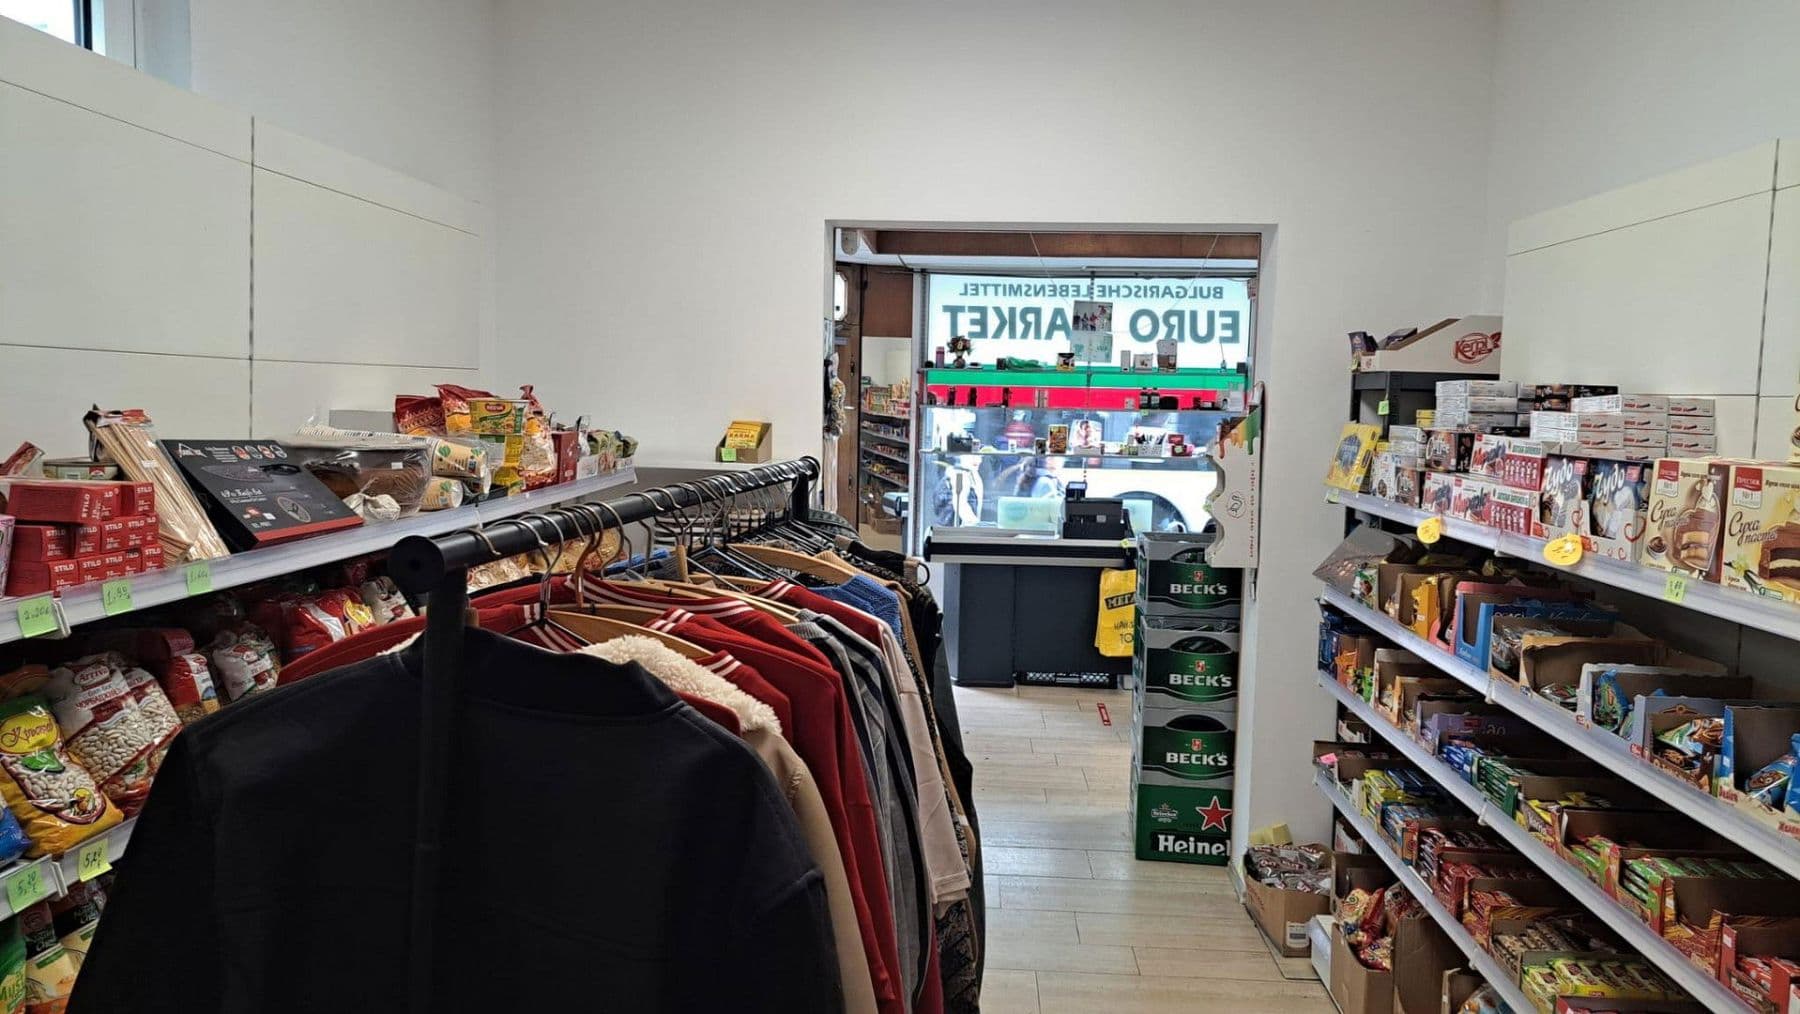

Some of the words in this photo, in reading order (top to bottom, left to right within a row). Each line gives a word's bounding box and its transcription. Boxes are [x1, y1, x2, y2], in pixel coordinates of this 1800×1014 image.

[105, 522, 123, 531] STILO
[1728, 510, 1761, 546] Суха
[82, 559, 102, 569] STILO
[105, 555, 123, 565] STILO
[54, 563, 75, 573] STILO
[1169, 582, 1228, 595] BECK'S
[1168, 673, 1232, 687] BECK'S
[1165, 751, 1228, 766] BECK'S
